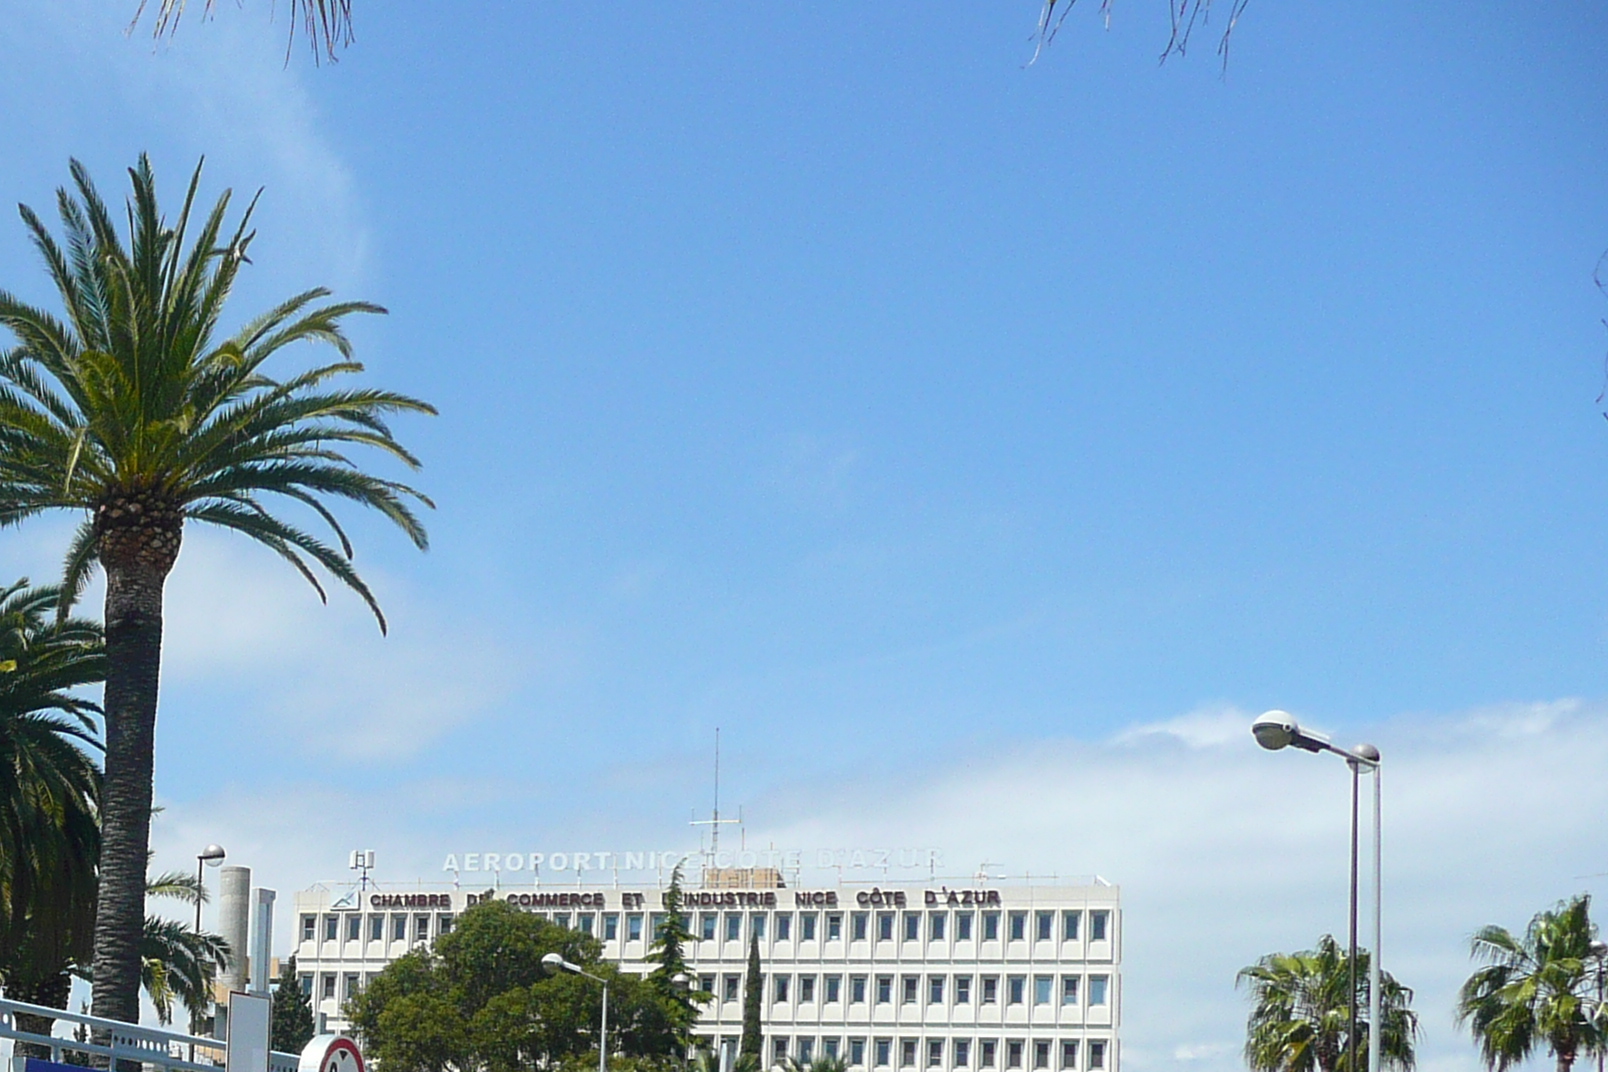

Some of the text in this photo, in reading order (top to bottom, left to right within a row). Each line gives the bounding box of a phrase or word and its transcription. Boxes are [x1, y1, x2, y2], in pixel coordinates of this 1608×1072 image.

[442, 851, 611, 872] AEROPORT
[625, 850, 702, 870] NICE
[370, 894, 450, 907] CHAMBRE
[507, 892, 603, 907] COMMERCE
[622, 892, 642, 907] ET
[662, 892, 776, 906] LINDUSTRIE
[795, 891, 837, 905] NICE
[856, 887, 905, 905] CÔTE
[924, 886, 1000, 905] D'AZUR
